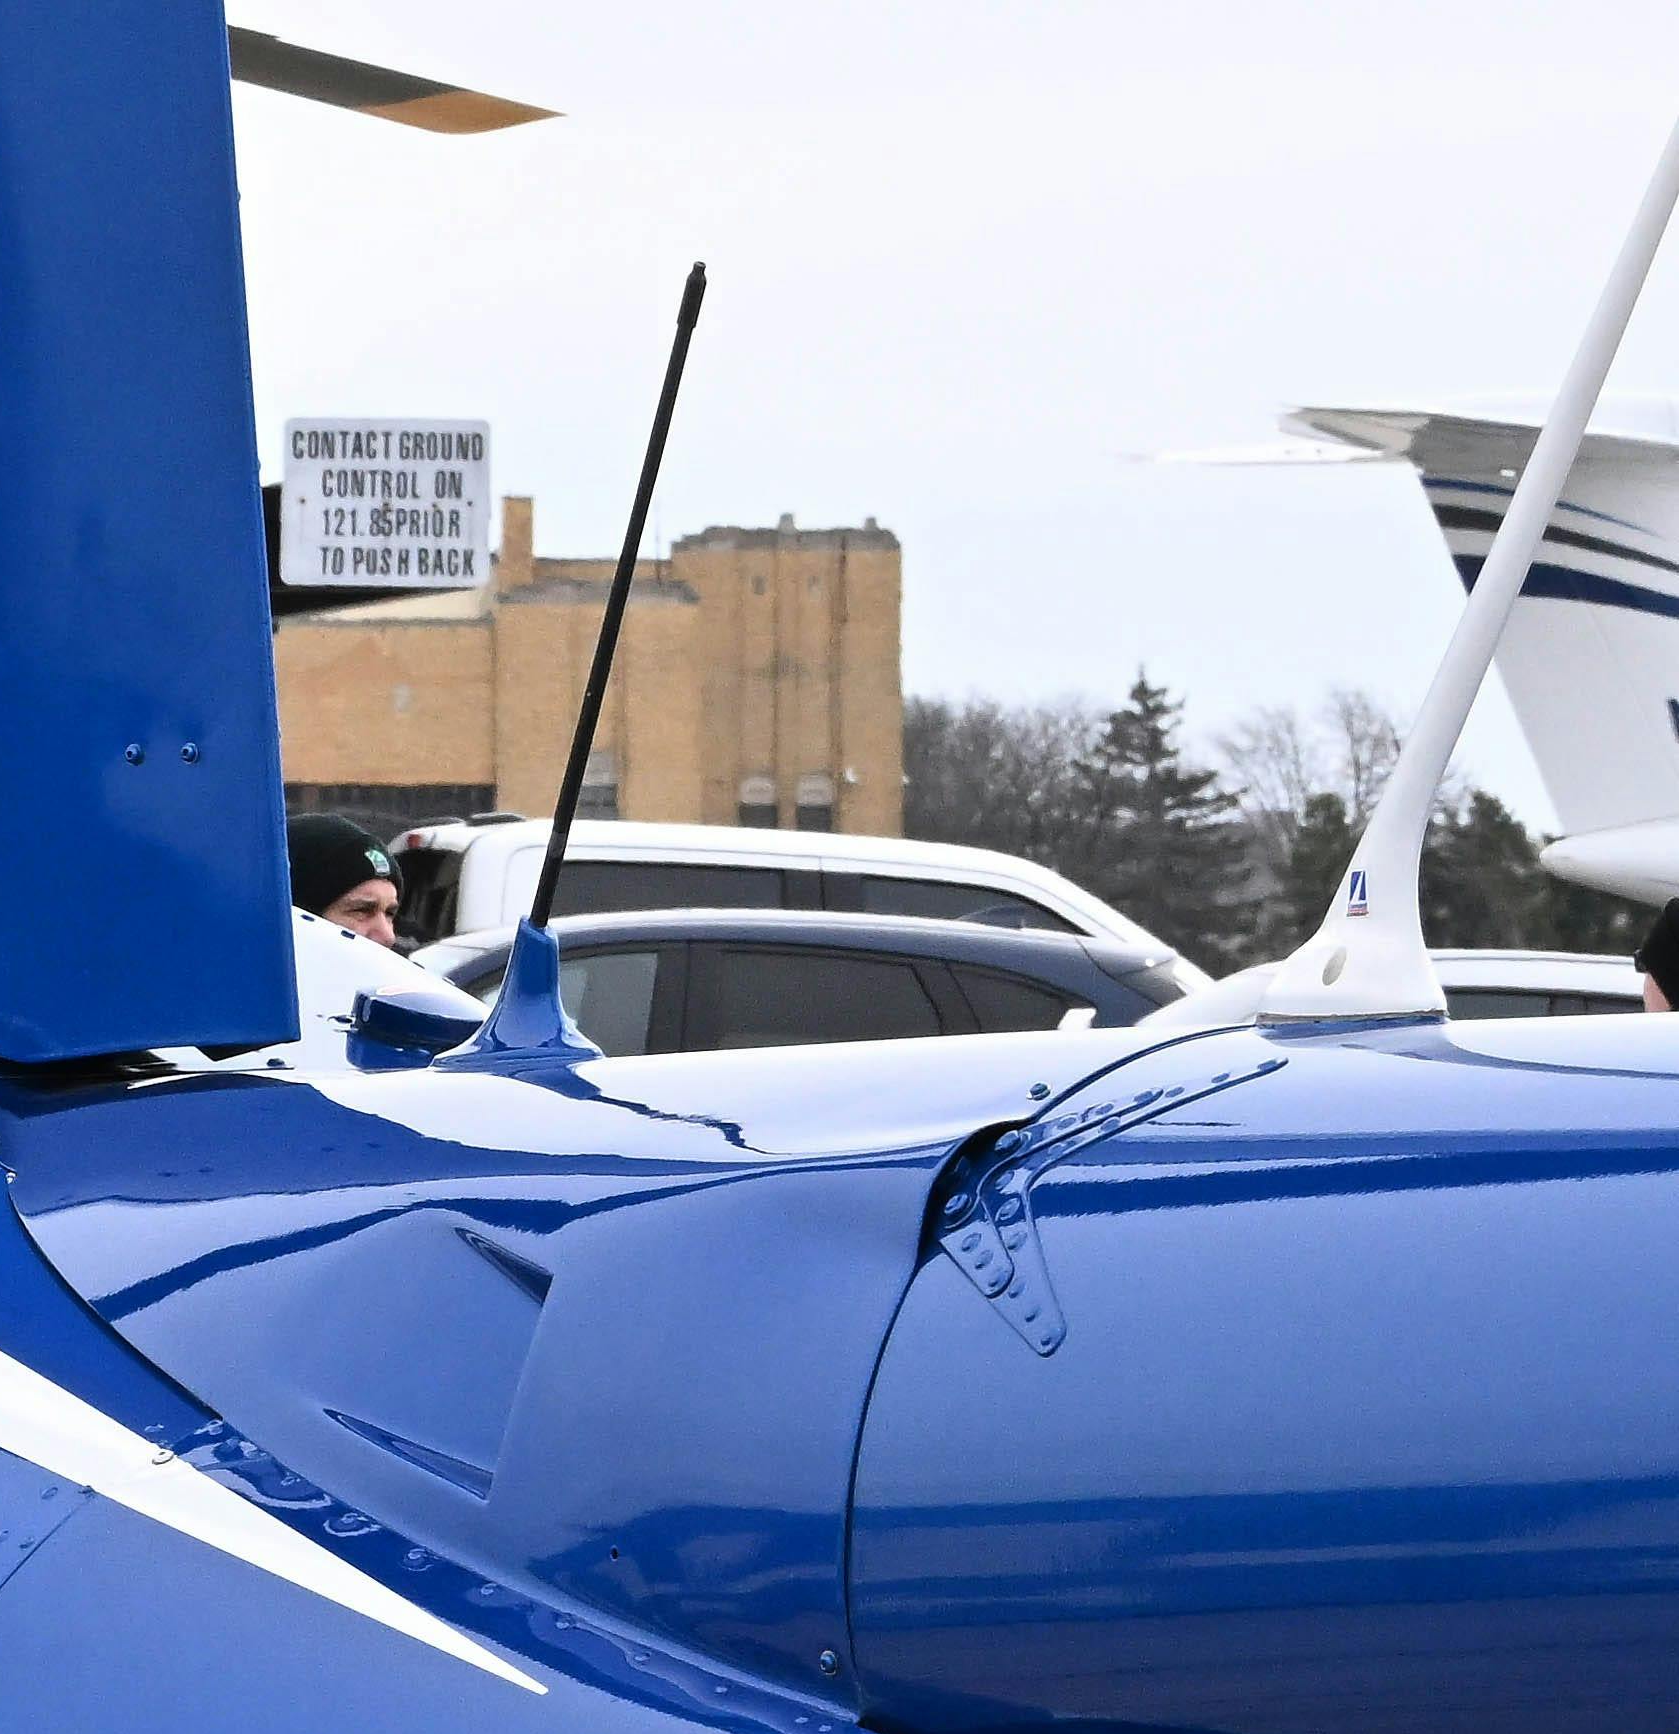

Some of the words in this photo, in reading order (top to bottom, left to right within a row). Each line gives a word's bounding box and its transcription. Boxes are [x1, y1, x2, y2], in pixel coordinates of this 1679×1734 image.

[291, 430, 392, 460] CONTACT
[398, 431, 484, 462] GROUND
[321, 469, 420, 499] CONTROL
[434, 470, 464, 499] ON
[394, 508, 461, 539] PRIOR
[320, 546, 345, 577] TO
[352, 547, 410, 577] PUSH
[417, 547, 476, 577] BACK
